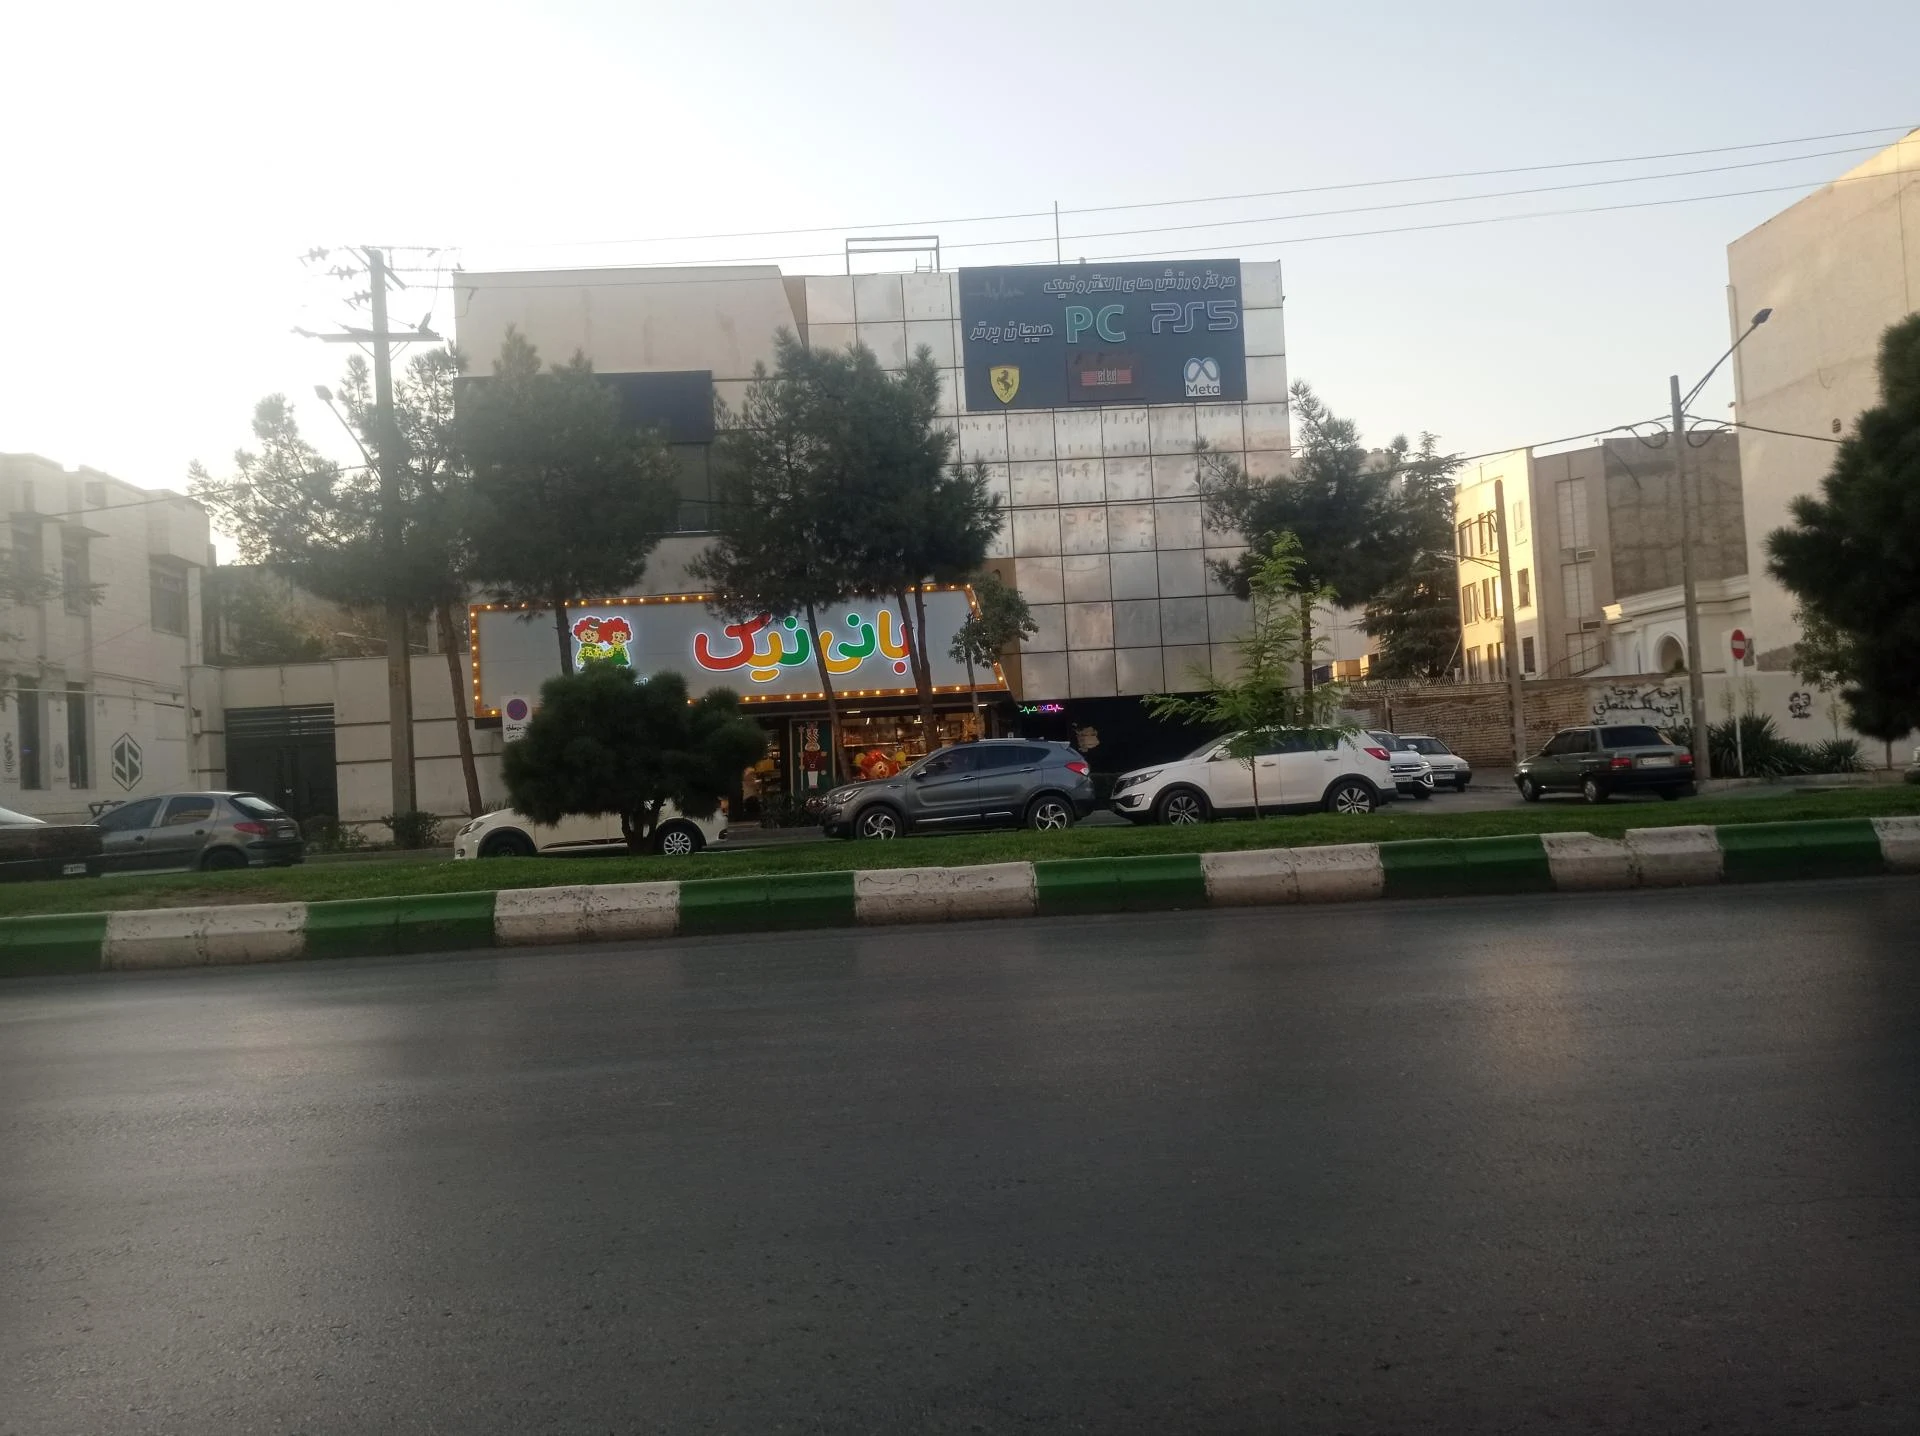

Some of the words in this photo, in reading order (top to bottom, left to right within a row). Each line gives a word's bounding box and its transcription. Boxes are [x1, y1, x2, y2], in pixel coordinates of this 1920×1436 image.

[1043, 274, 1122, 299] الکترونیک
[1123, 277, 1153, 293] های
[1155, 268, 1200, 291] ورزش
[1203, 270, 1236, 289] مرکز
[1065, 304, 1126, 344] PC
[1151, 300, 1239, 334] PS5
[969, 320, 1001, 344] برتر
[1004, 320, 1053, 343] هیجان
[1186, 384, 1220, 396] Meta
[694, 611, 811, 682] نیک
